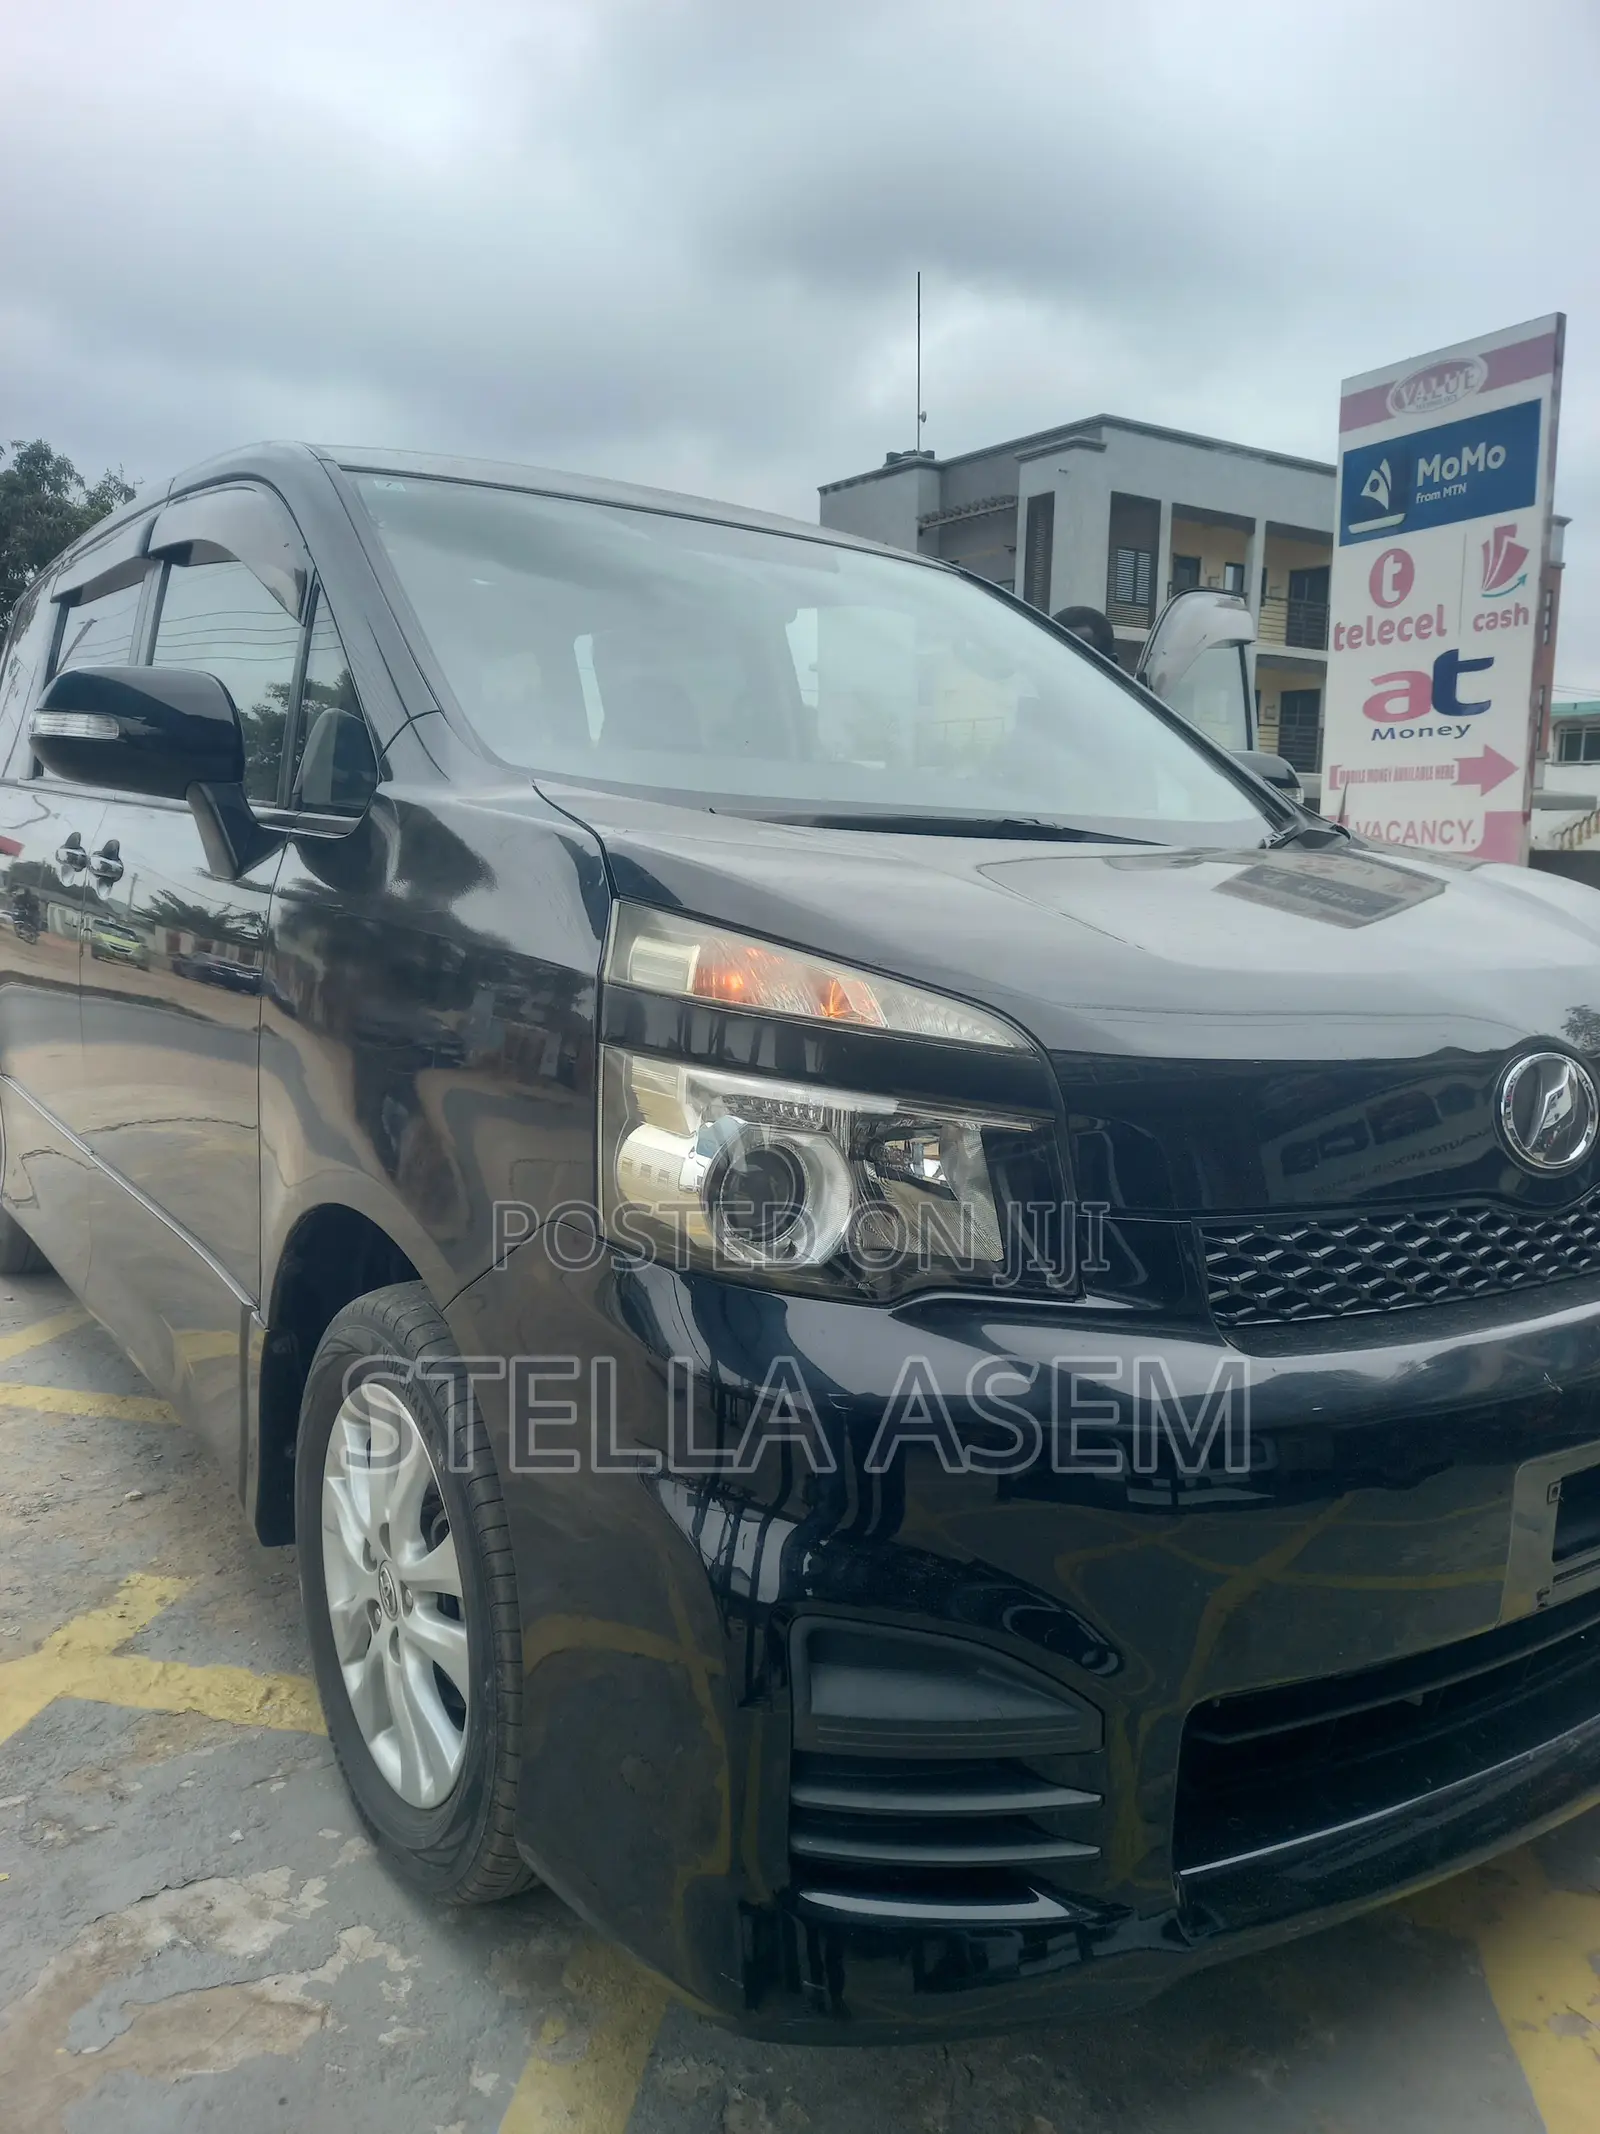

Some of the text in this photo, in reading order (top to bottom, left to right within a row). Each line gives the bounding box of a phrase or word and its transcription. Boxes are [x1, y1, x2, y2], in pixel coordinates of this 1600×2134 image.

[1400, 363, 1477, 406] VALUE
[1417, 442, 1506, 487] MoMo
[1416, 482, 1467, 504] from MTN
[1334, 602, 1530, 651] telecel cash
[1363, 649, 1494, 722] at
[1371, 724, 1471, 741] Money
[1435, 764, 1456, 780] HERE
